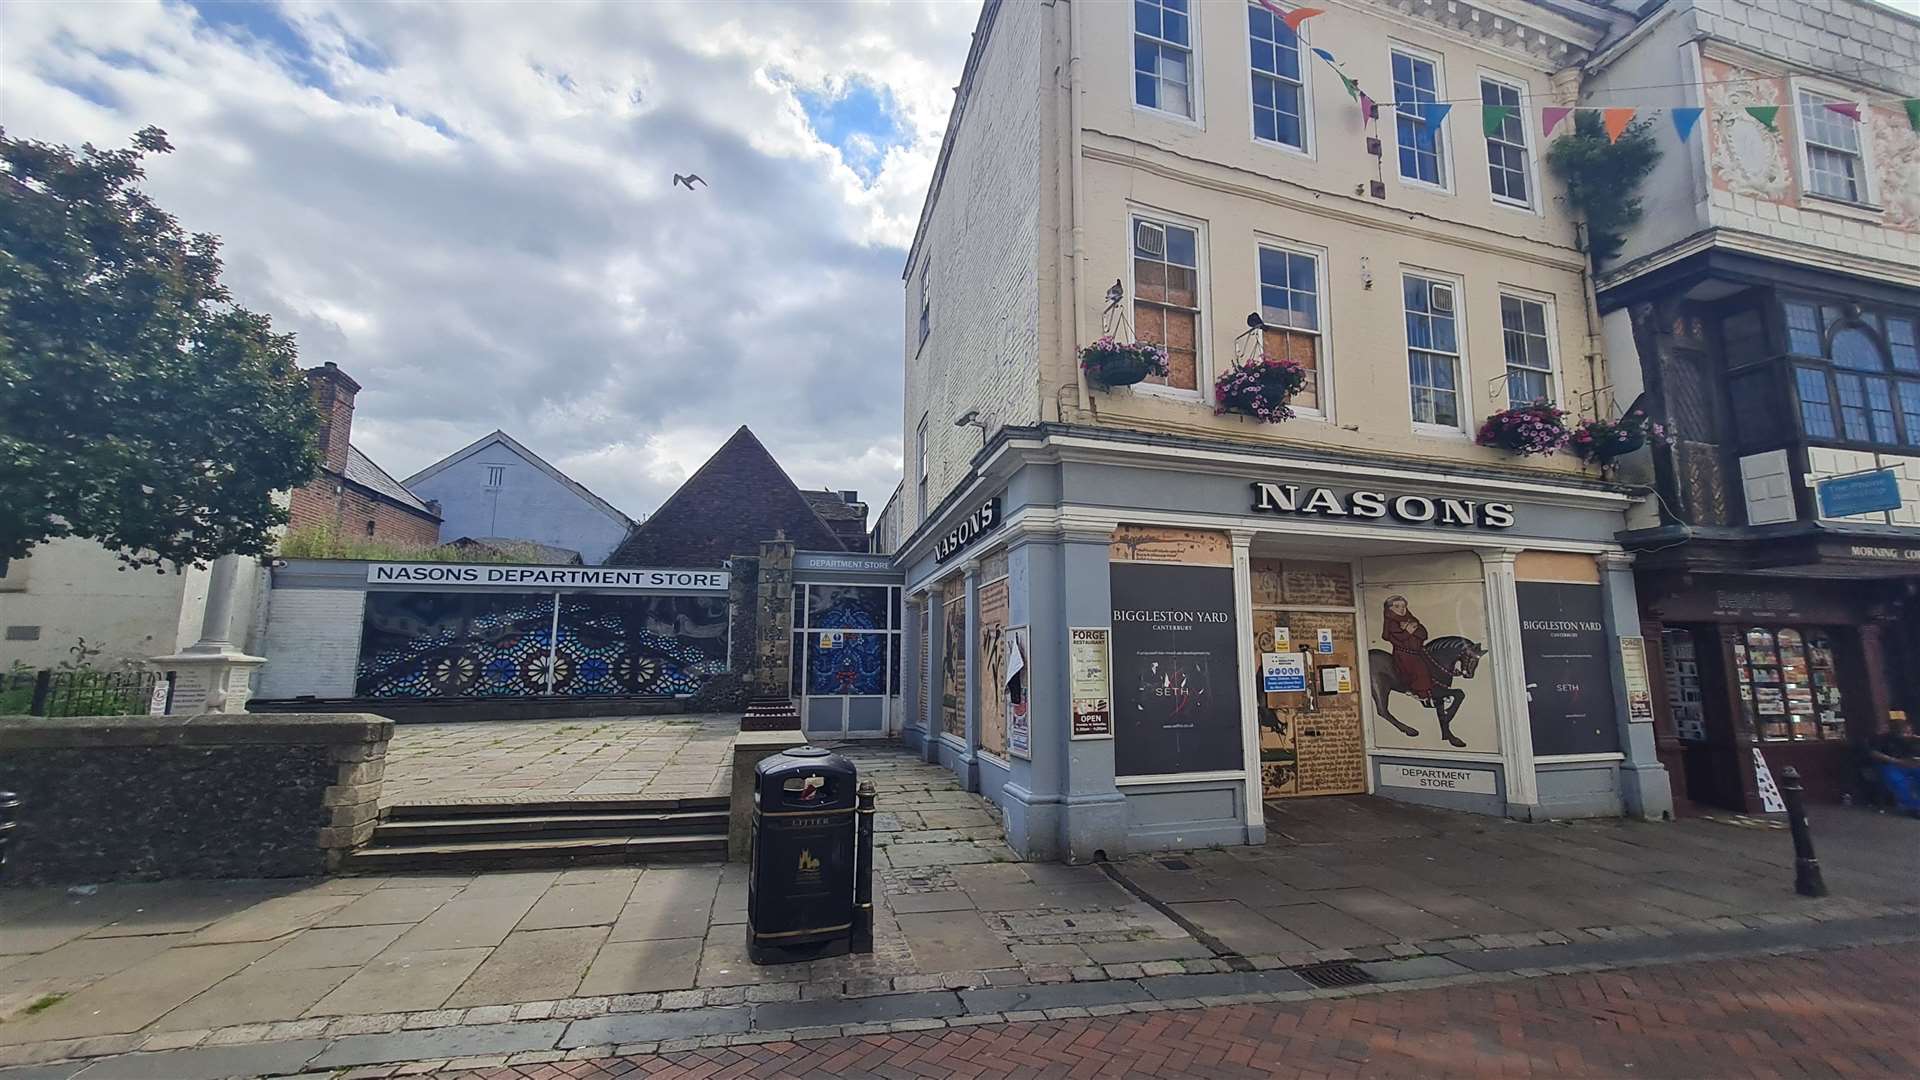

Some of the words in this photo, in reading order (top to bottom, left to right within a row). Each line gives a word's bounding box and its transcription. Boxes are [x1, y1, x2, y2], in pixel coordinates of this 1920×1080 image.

[1253, 482, 1516, 528] NASONS
[1851, 545, 1897, 559] MORNING
[809, 559, 862, 568] DEPARTMENT
[864, 561, 889, 570] STORE
[376, 567, 478, 581] NASONS
[487, 569, 644, 585] DEPARTMENT
[650, 573, 721, 587] STORE
[1113, 610, 1194, 623] BIGGLESTON
[1197, 611, 1228, 623] YARD
[1523, 621, 1578, 631] BIGGLESTON
[1580, 622, 1602, 631] YARD
[1072, 630, 1105, 640] FORGE
[1155, 687, 1189, 697] SETH
[1080, 715, 1102, 723] OPEN
[1402, 768, 1471, 781] DEPARTMENT
[1420, 779, 1455, 789] STORE
